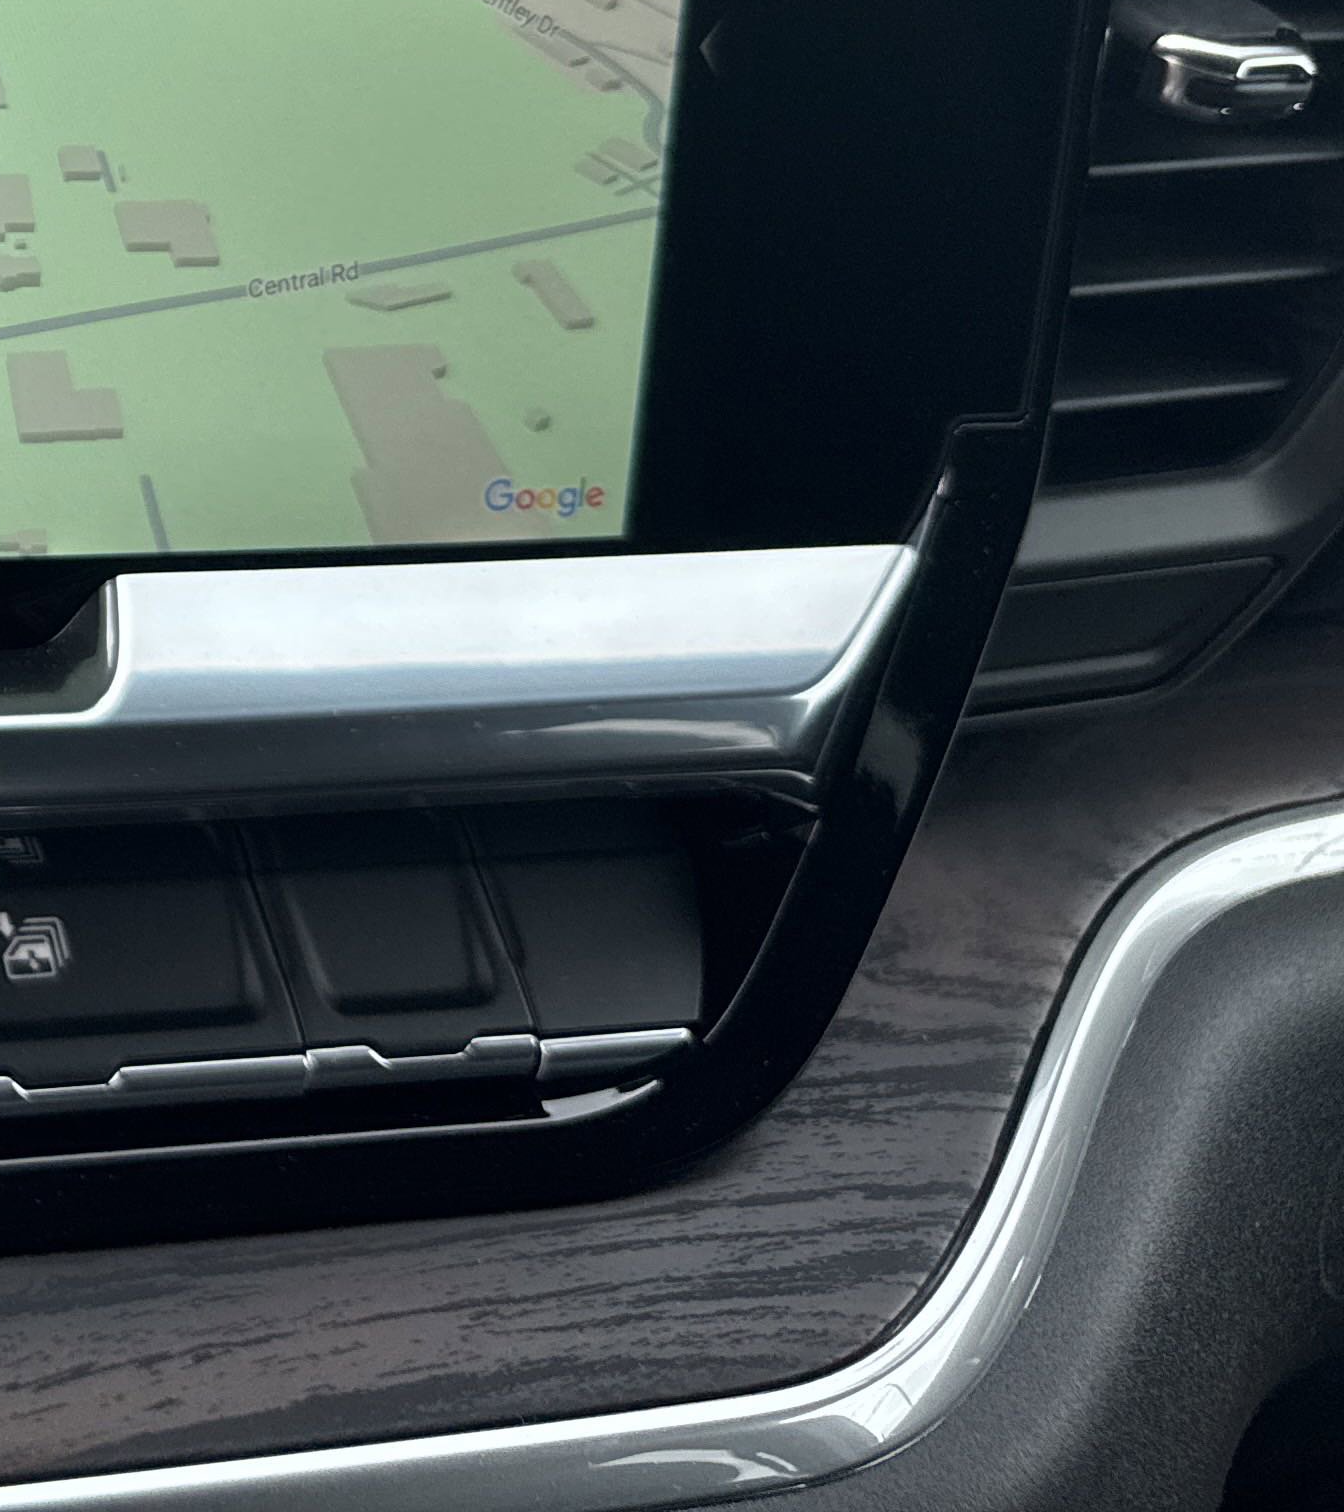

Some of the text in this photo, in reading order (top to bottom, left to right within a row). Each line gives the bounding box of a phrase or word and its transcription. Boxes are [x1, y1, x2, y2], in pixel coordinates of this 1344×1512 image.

[537, 14, 563, 38] Dr
[248, 260, 360, 300] Central Rd
[482, 477, 605, 519] Google
